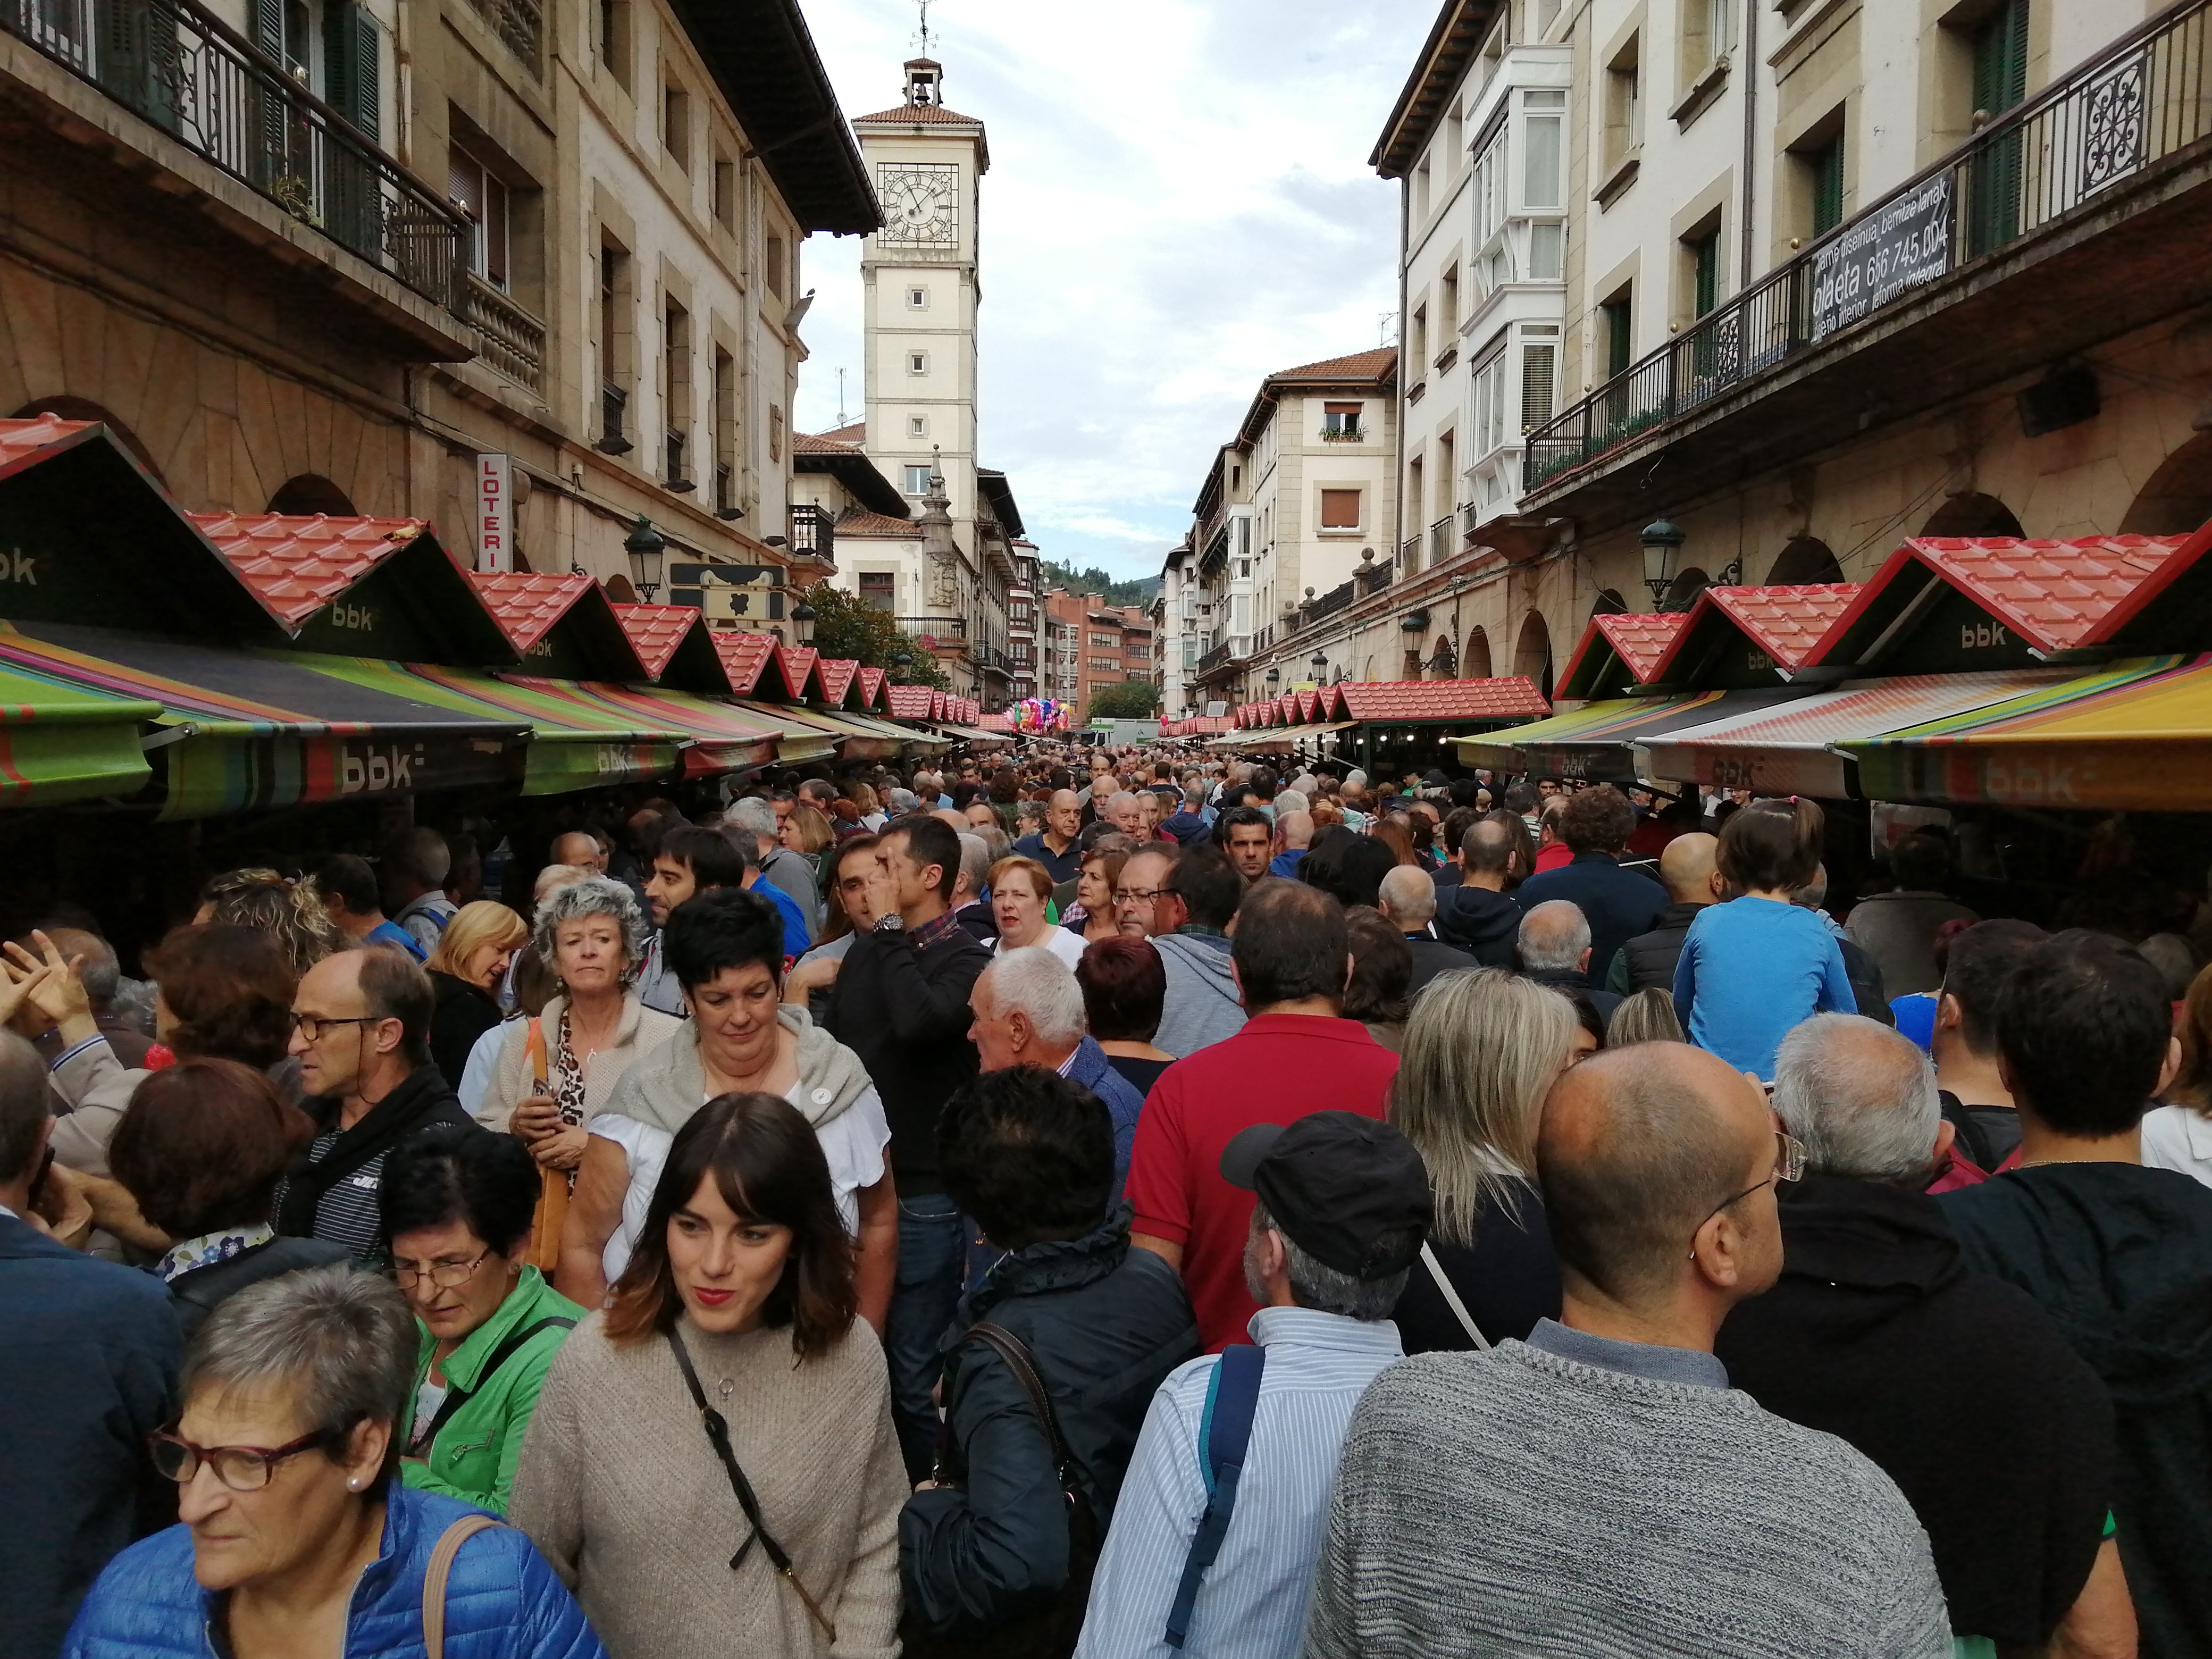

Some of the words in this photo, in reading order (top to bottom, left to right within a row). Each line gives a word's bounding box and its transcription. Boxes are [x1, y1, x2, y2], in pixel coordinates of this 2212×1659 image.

[1881, 200, 1916, 234] berritze
[1918, 178, 1946, 212] lanak
[1813, 261, 1860, 316] olaeta
[1867, 248, 1889, 287] 656
[1892, 232, 1919, 272] 745
[1923, 213, 1948, 258] 004
[1839, 298, 1867, 328] interior
[1872, 279, 1904, 311] reforma
[1906, 252, 1947, 290] integral
[483, 461, 500, 573] LOTERI
[333, 601, 372, 631] bbk
[1962, 622, 2006, 649] bbk
[342, 744, 412, 794] bbk
[1562, 752, 1586, 776] bbk
[1987, 757, 2079, 802] bbk
